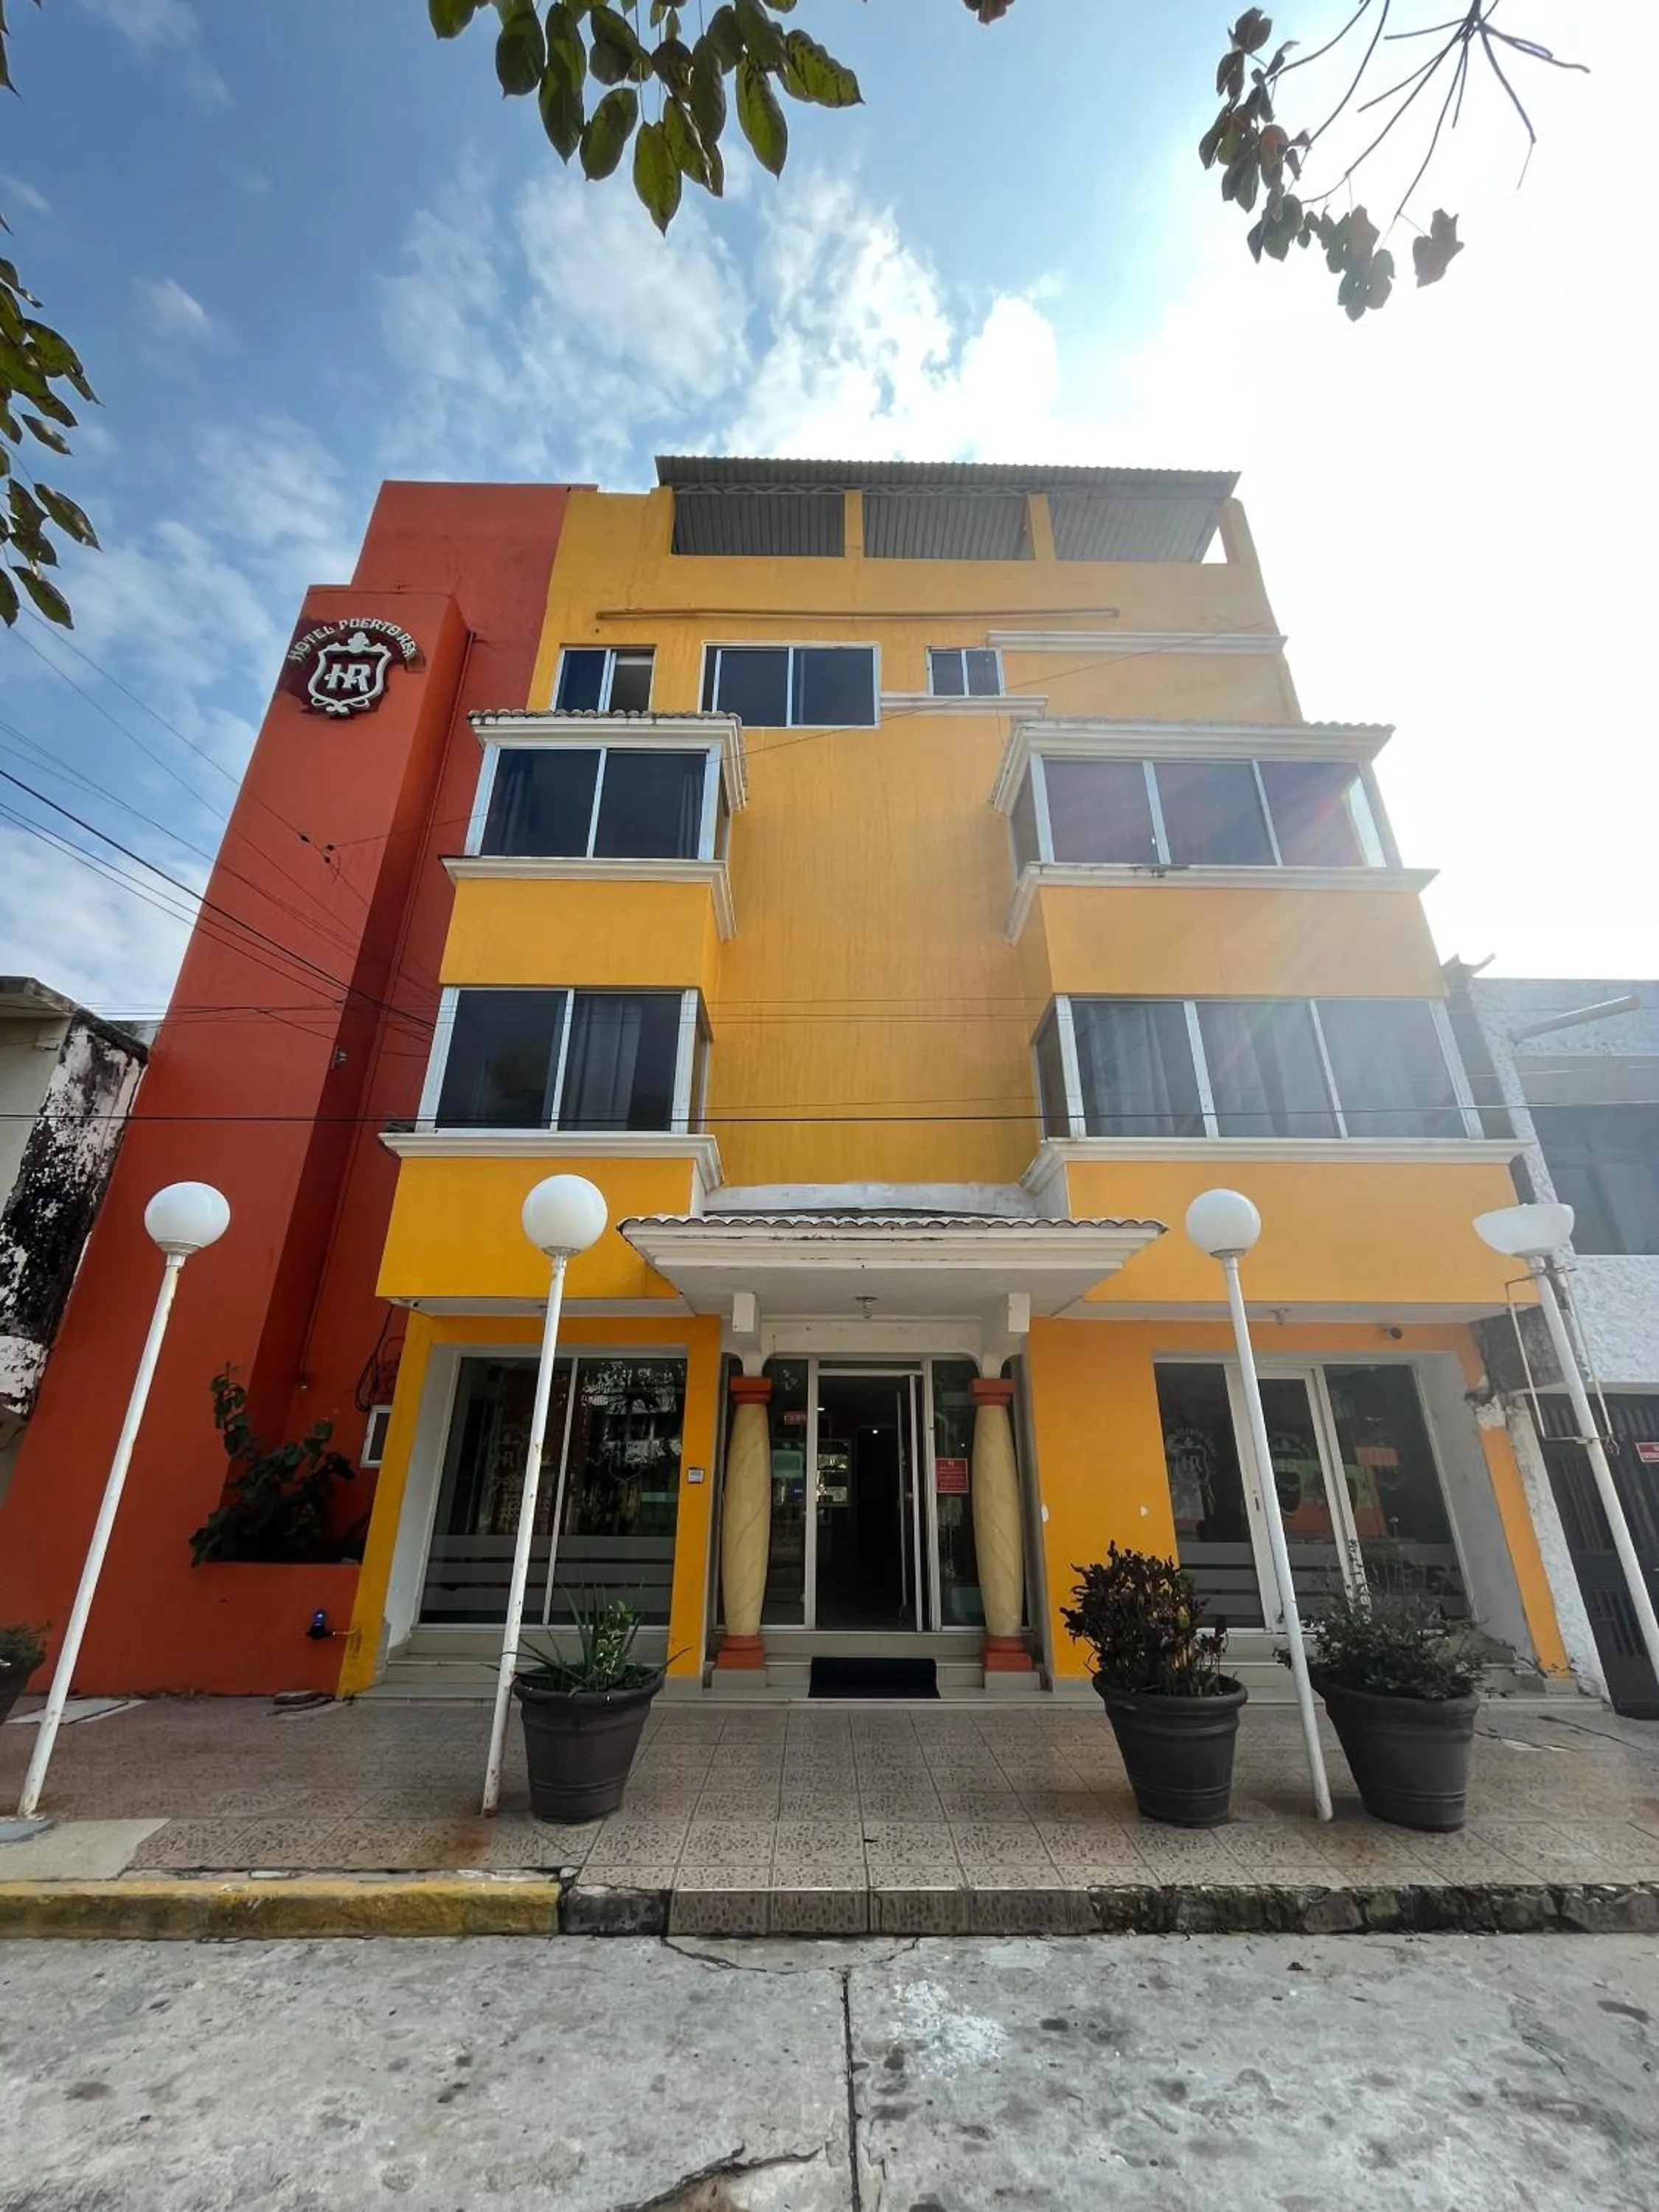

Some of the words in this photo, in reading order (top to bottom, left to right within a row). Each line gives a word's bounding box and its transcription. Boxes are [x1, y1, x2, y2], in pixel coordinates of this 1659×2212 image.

[288, 625, 335, 662] HOTEL
[338, 618, 402, 636] PUERTO
[324, 664, 370, 692] HR
